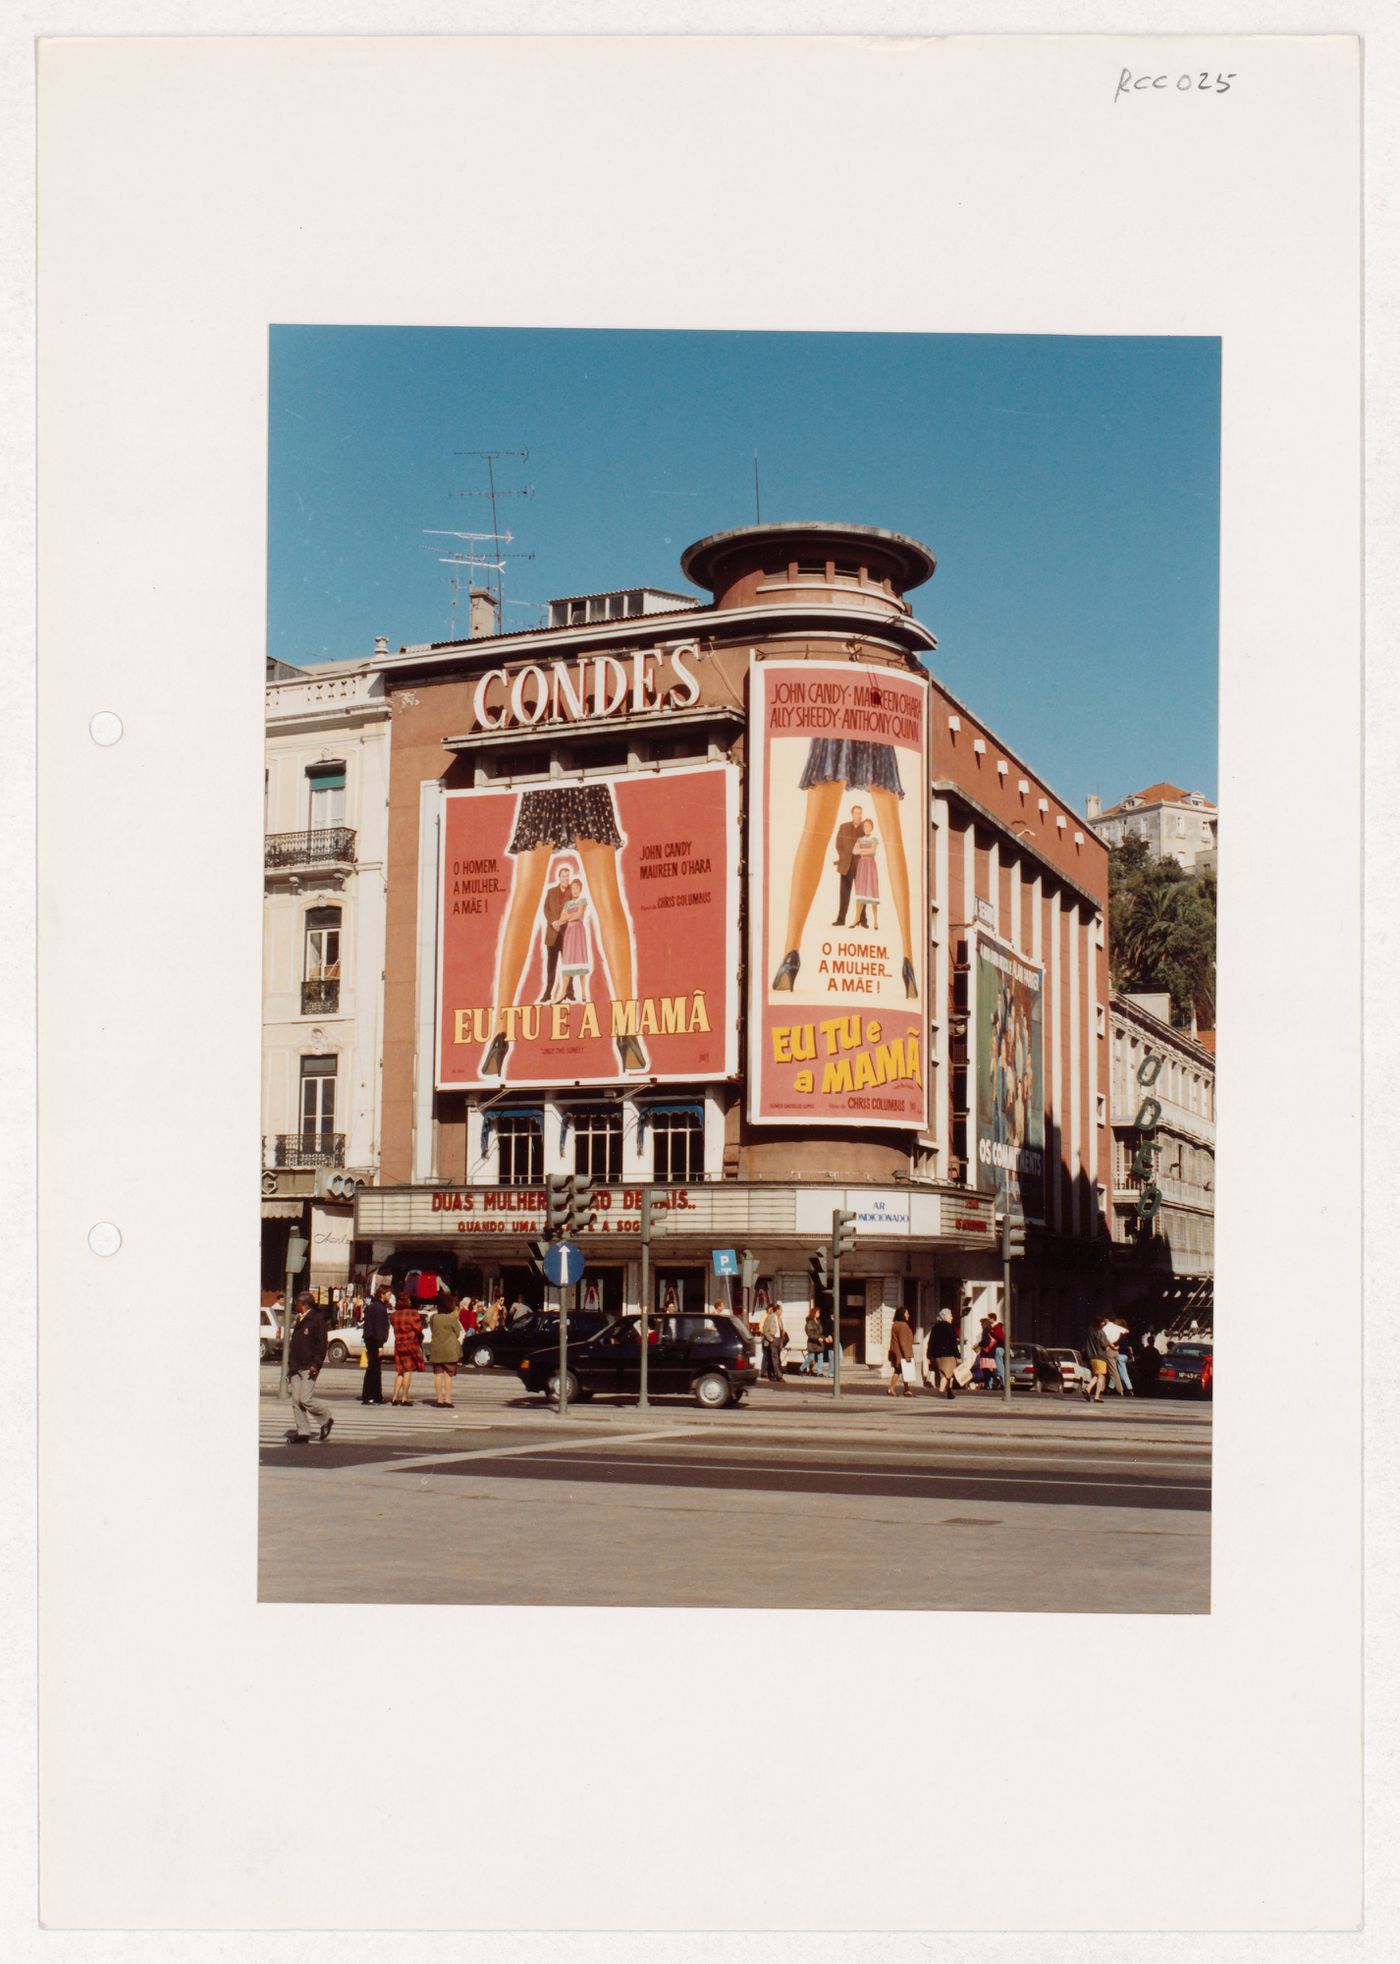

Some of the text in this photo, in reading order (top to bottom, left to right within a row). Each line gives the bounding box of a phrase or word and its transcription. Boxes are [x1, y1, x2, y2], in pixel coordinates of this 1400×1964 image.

[473, 645, 700, 730] CONDES
[771, 683, 805, 704] JOHN
[808, 683, 849, 704] CANDY
[853, 685, 899, 713] MAREEN
[770, 707, 919, 742] ALLY SHEEDY ANTHONY QUINN
[640, 841, 692, 861] JOHN CANDY
[453, 861, 460, 875] O
[640, 858, 711, 880] MAUREEN O'HARA
[453, 881, 460, 895] A
[453, 901, 460, 915] A
[462, 897, 482, 914] MÃE
[657, 896, 675, 909] CHRIS
[676, 891, 712, 907] COLUMBUS
[822, 942, 832, 956] O
[819, 960, 829, 974] A
[827, 978, 838, 992] A
[842, 976, 873, 993] MÃE
[453, 1007, 494, 1045] EU
[500, 1004, 543, 1041] TU
[550, 1003, 571, 1041] E
[578, 1001, 602, 1039] A
[771, 1023, 817, 1063] EU
[820, 1015, 863, 1056] TU
[821, 1026, 923, 1095] MAMÃ
[848, 1097, 871, 1110] CHRIS
[872, 1098, 905, 1112] COLUMBUS
[980, 1138, 991, 1165] OS
[432, 1191, 474, 1212] DUAS
[873, 1201, 886, 1211] AR
[458, 1220, 505, 1233] QUANDO
[512, 1220, 537, 1233] UMA
[720, 1255, 730, 1267] P
